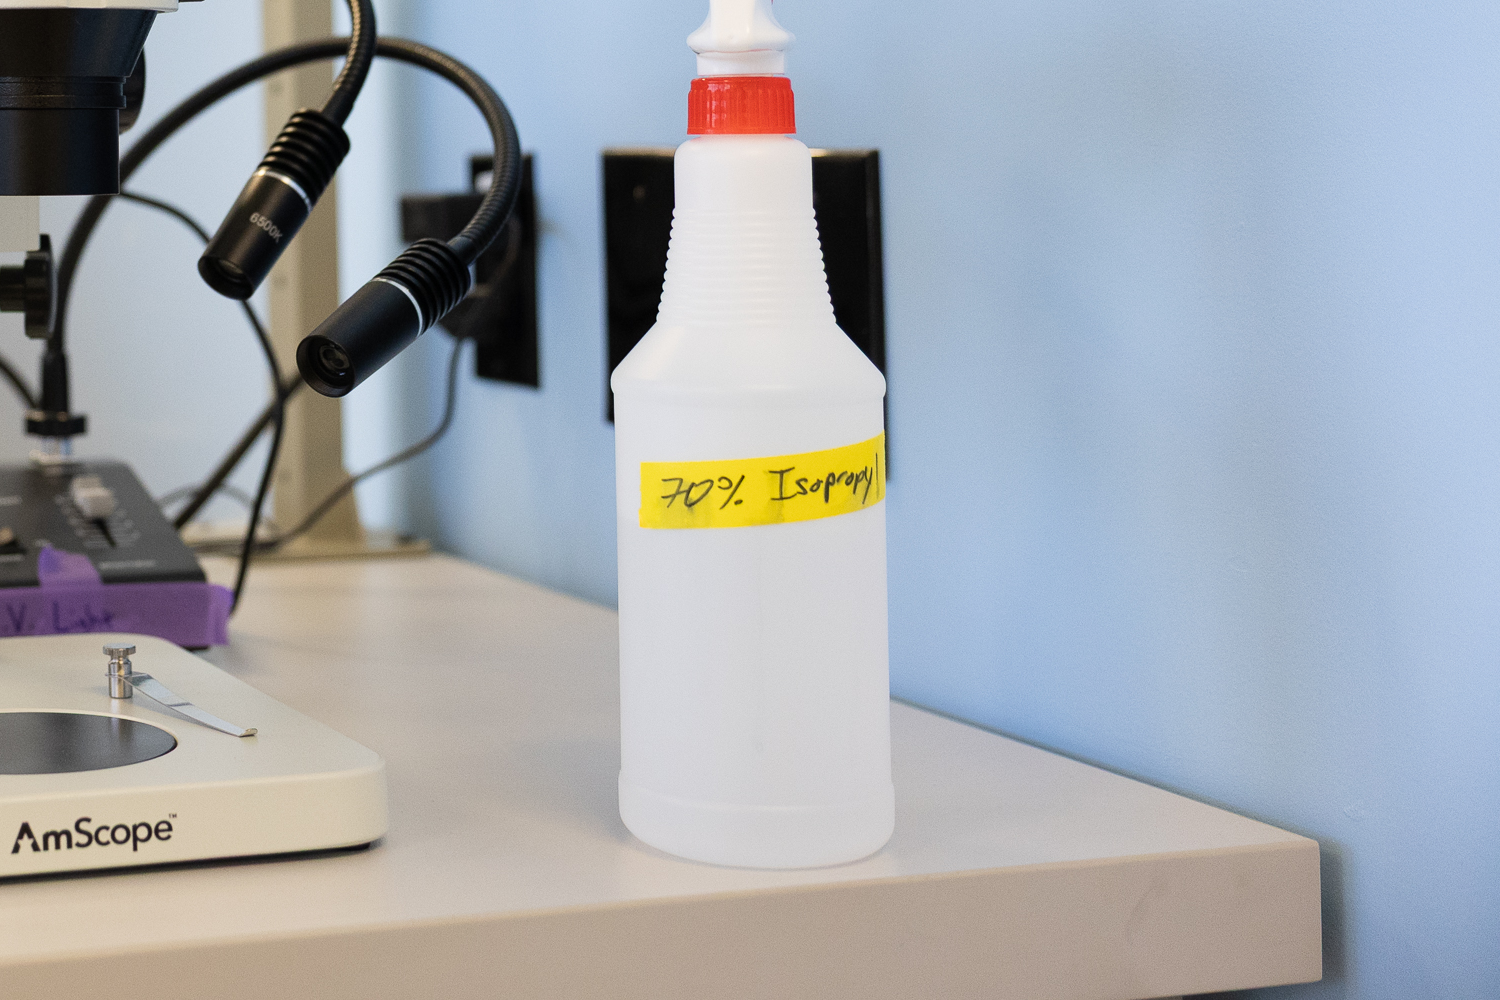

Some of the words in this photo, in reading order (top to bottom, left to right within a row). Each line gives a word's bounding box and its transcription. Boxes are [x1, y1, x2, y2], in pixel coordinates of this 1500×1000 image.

[250, 212, 283, 243] 6500K
[660, 473, 745, 510] 70%
[767, 452, 880, 505] Isopropyl
